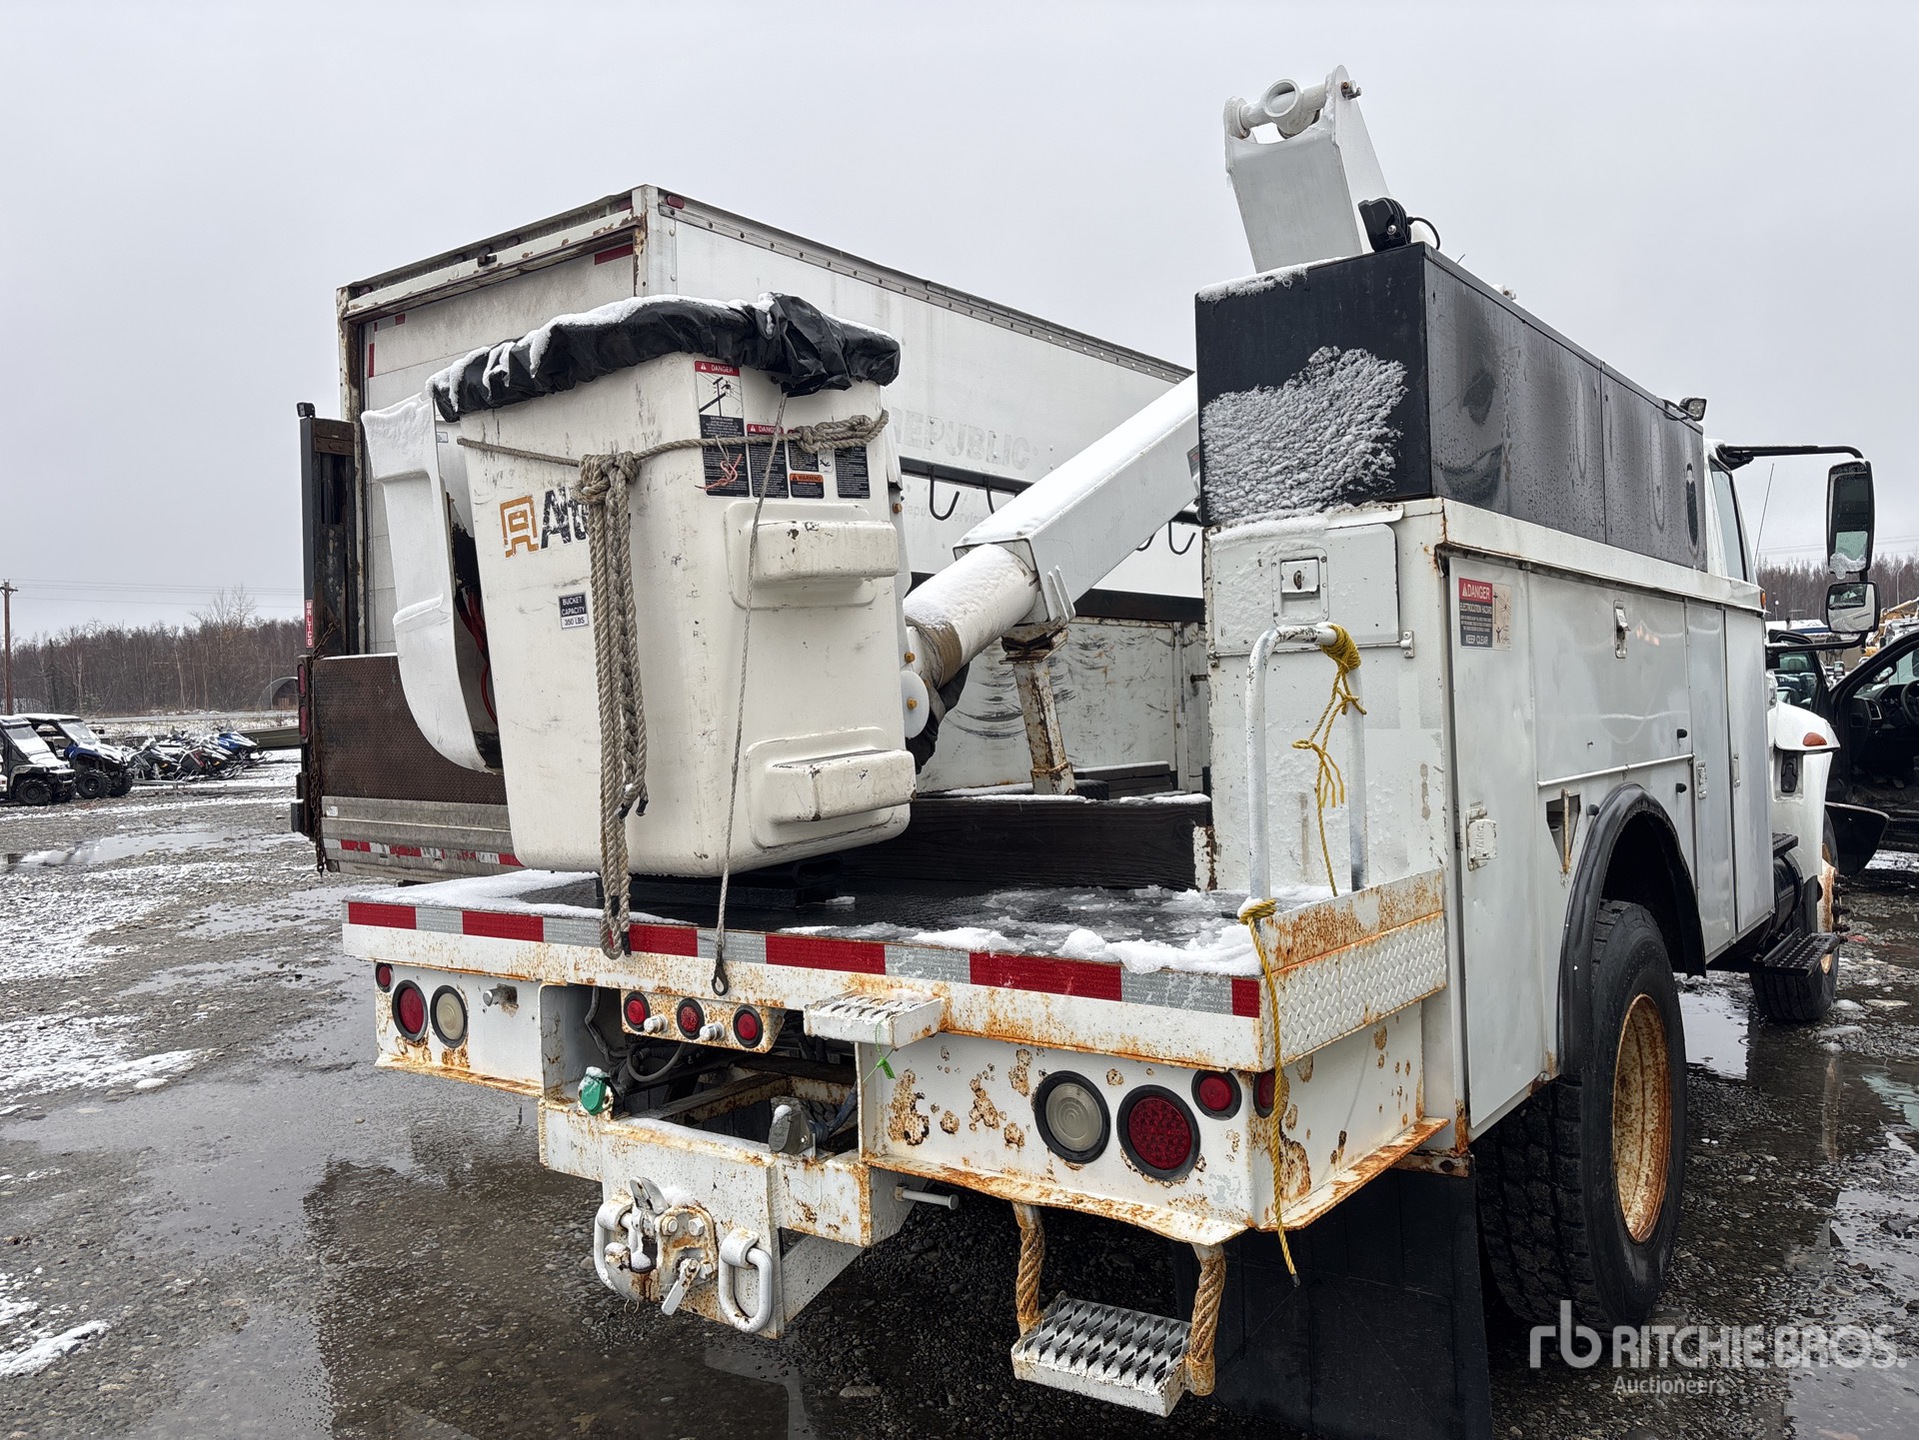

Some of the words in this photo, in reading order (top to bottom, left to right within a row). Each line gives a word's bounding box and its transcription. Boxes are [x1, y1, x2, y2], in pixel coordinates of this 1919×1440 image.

[711, 364, 734, 374] DANGER
[758, 425, 781, 434] DANG
[1467, 584, 1491, 600] DANGER
[562, 596, 583, 605] BUCKET
[561, 606, 585, 615] CAPACITY
[564, 619, 575, 627] 350
[575, 616, 585, 625] LBS
